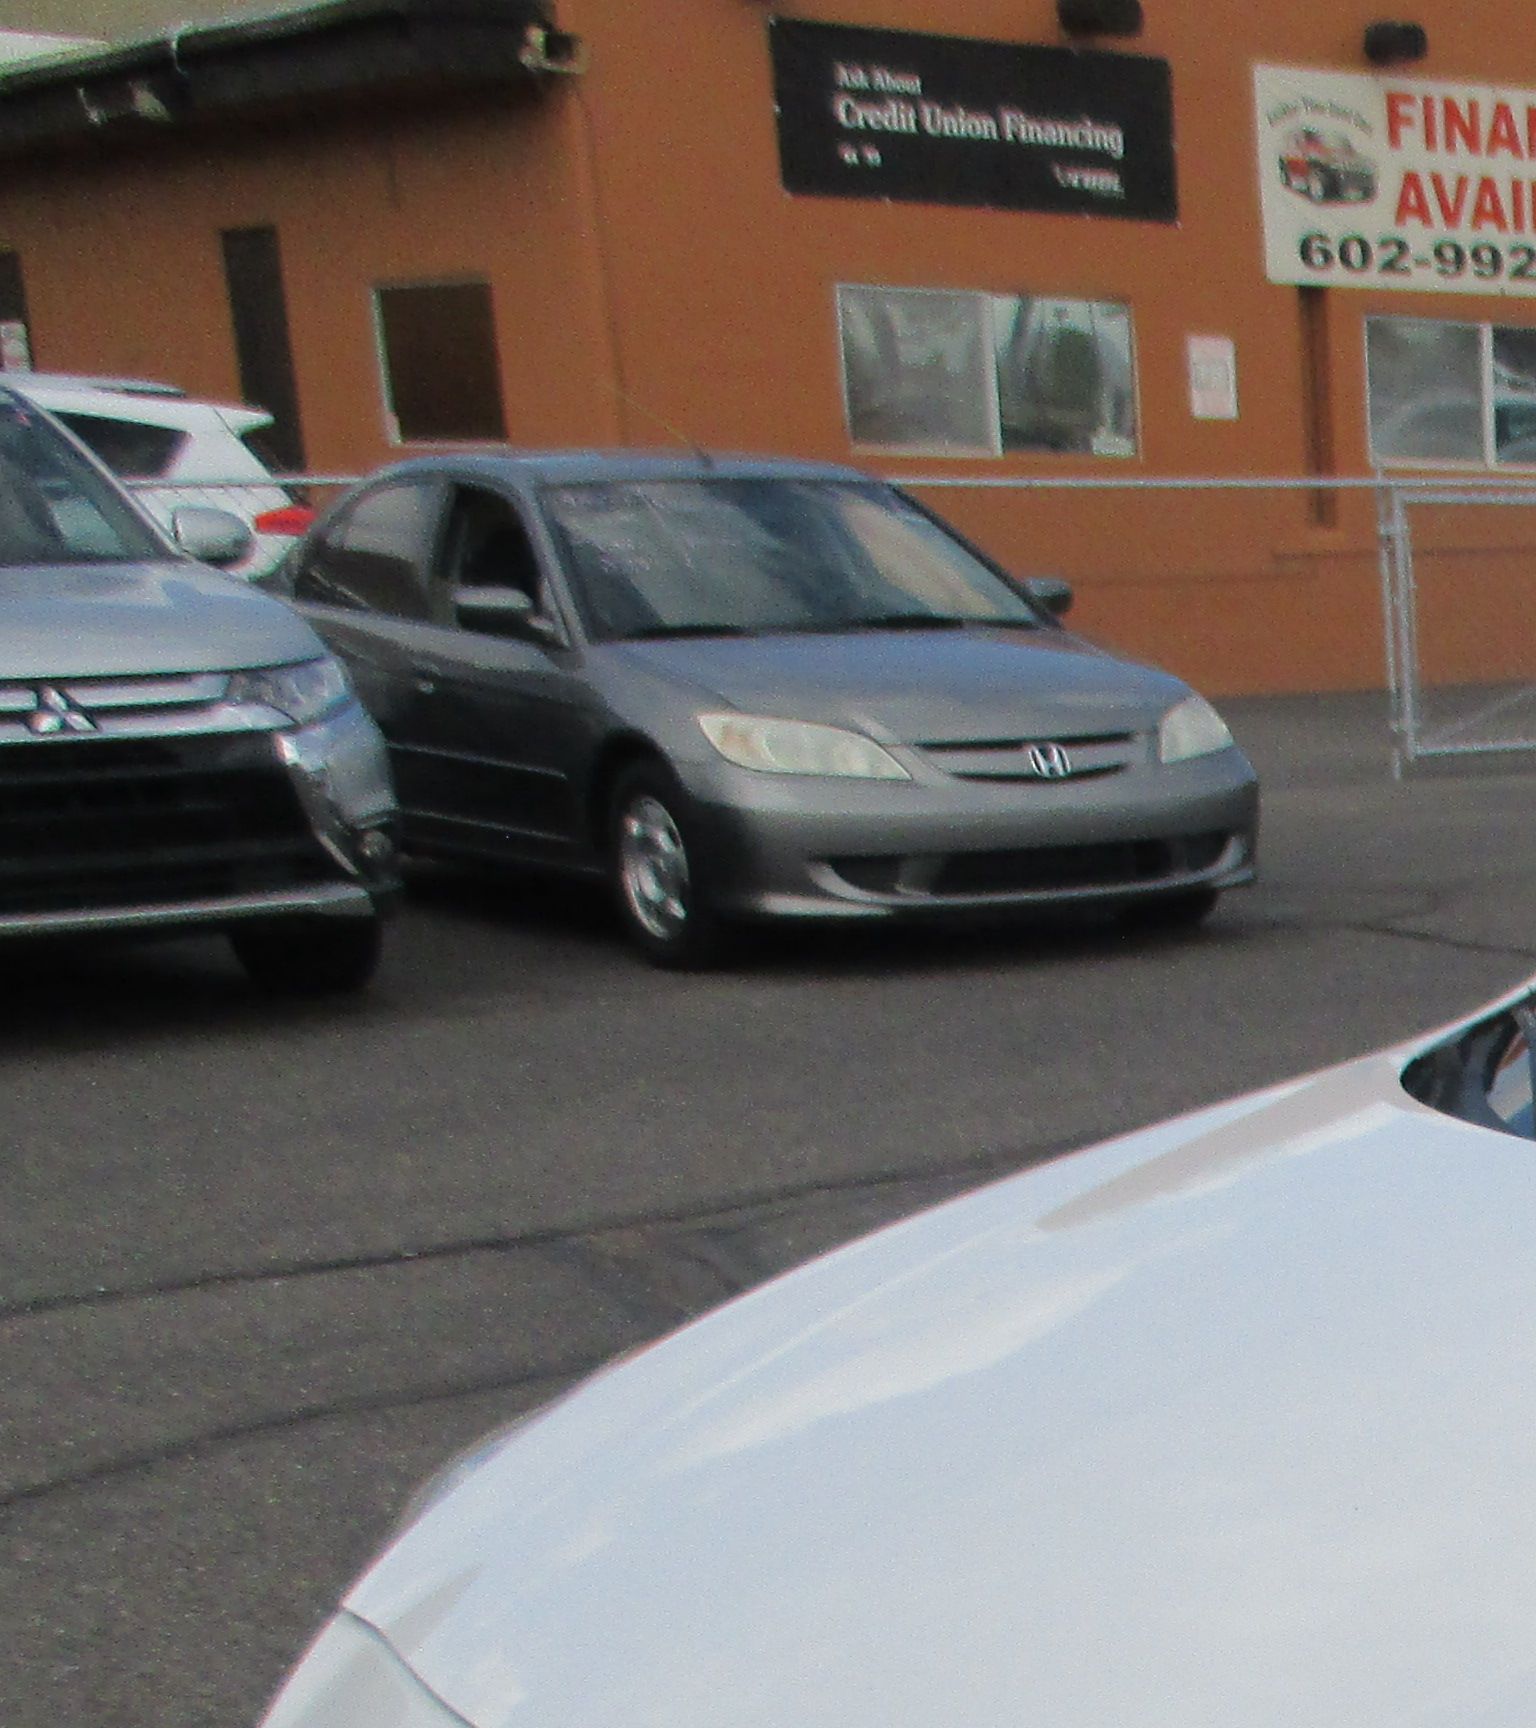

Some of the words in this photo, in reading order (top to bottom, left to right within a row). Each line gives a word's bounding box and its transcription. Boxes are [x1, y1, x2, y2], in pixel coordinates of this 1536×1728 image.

[834, 91, 918, 133] Credit
[919, 99, 999, 141] Union
[999, 105, 1124, 160] Financing
